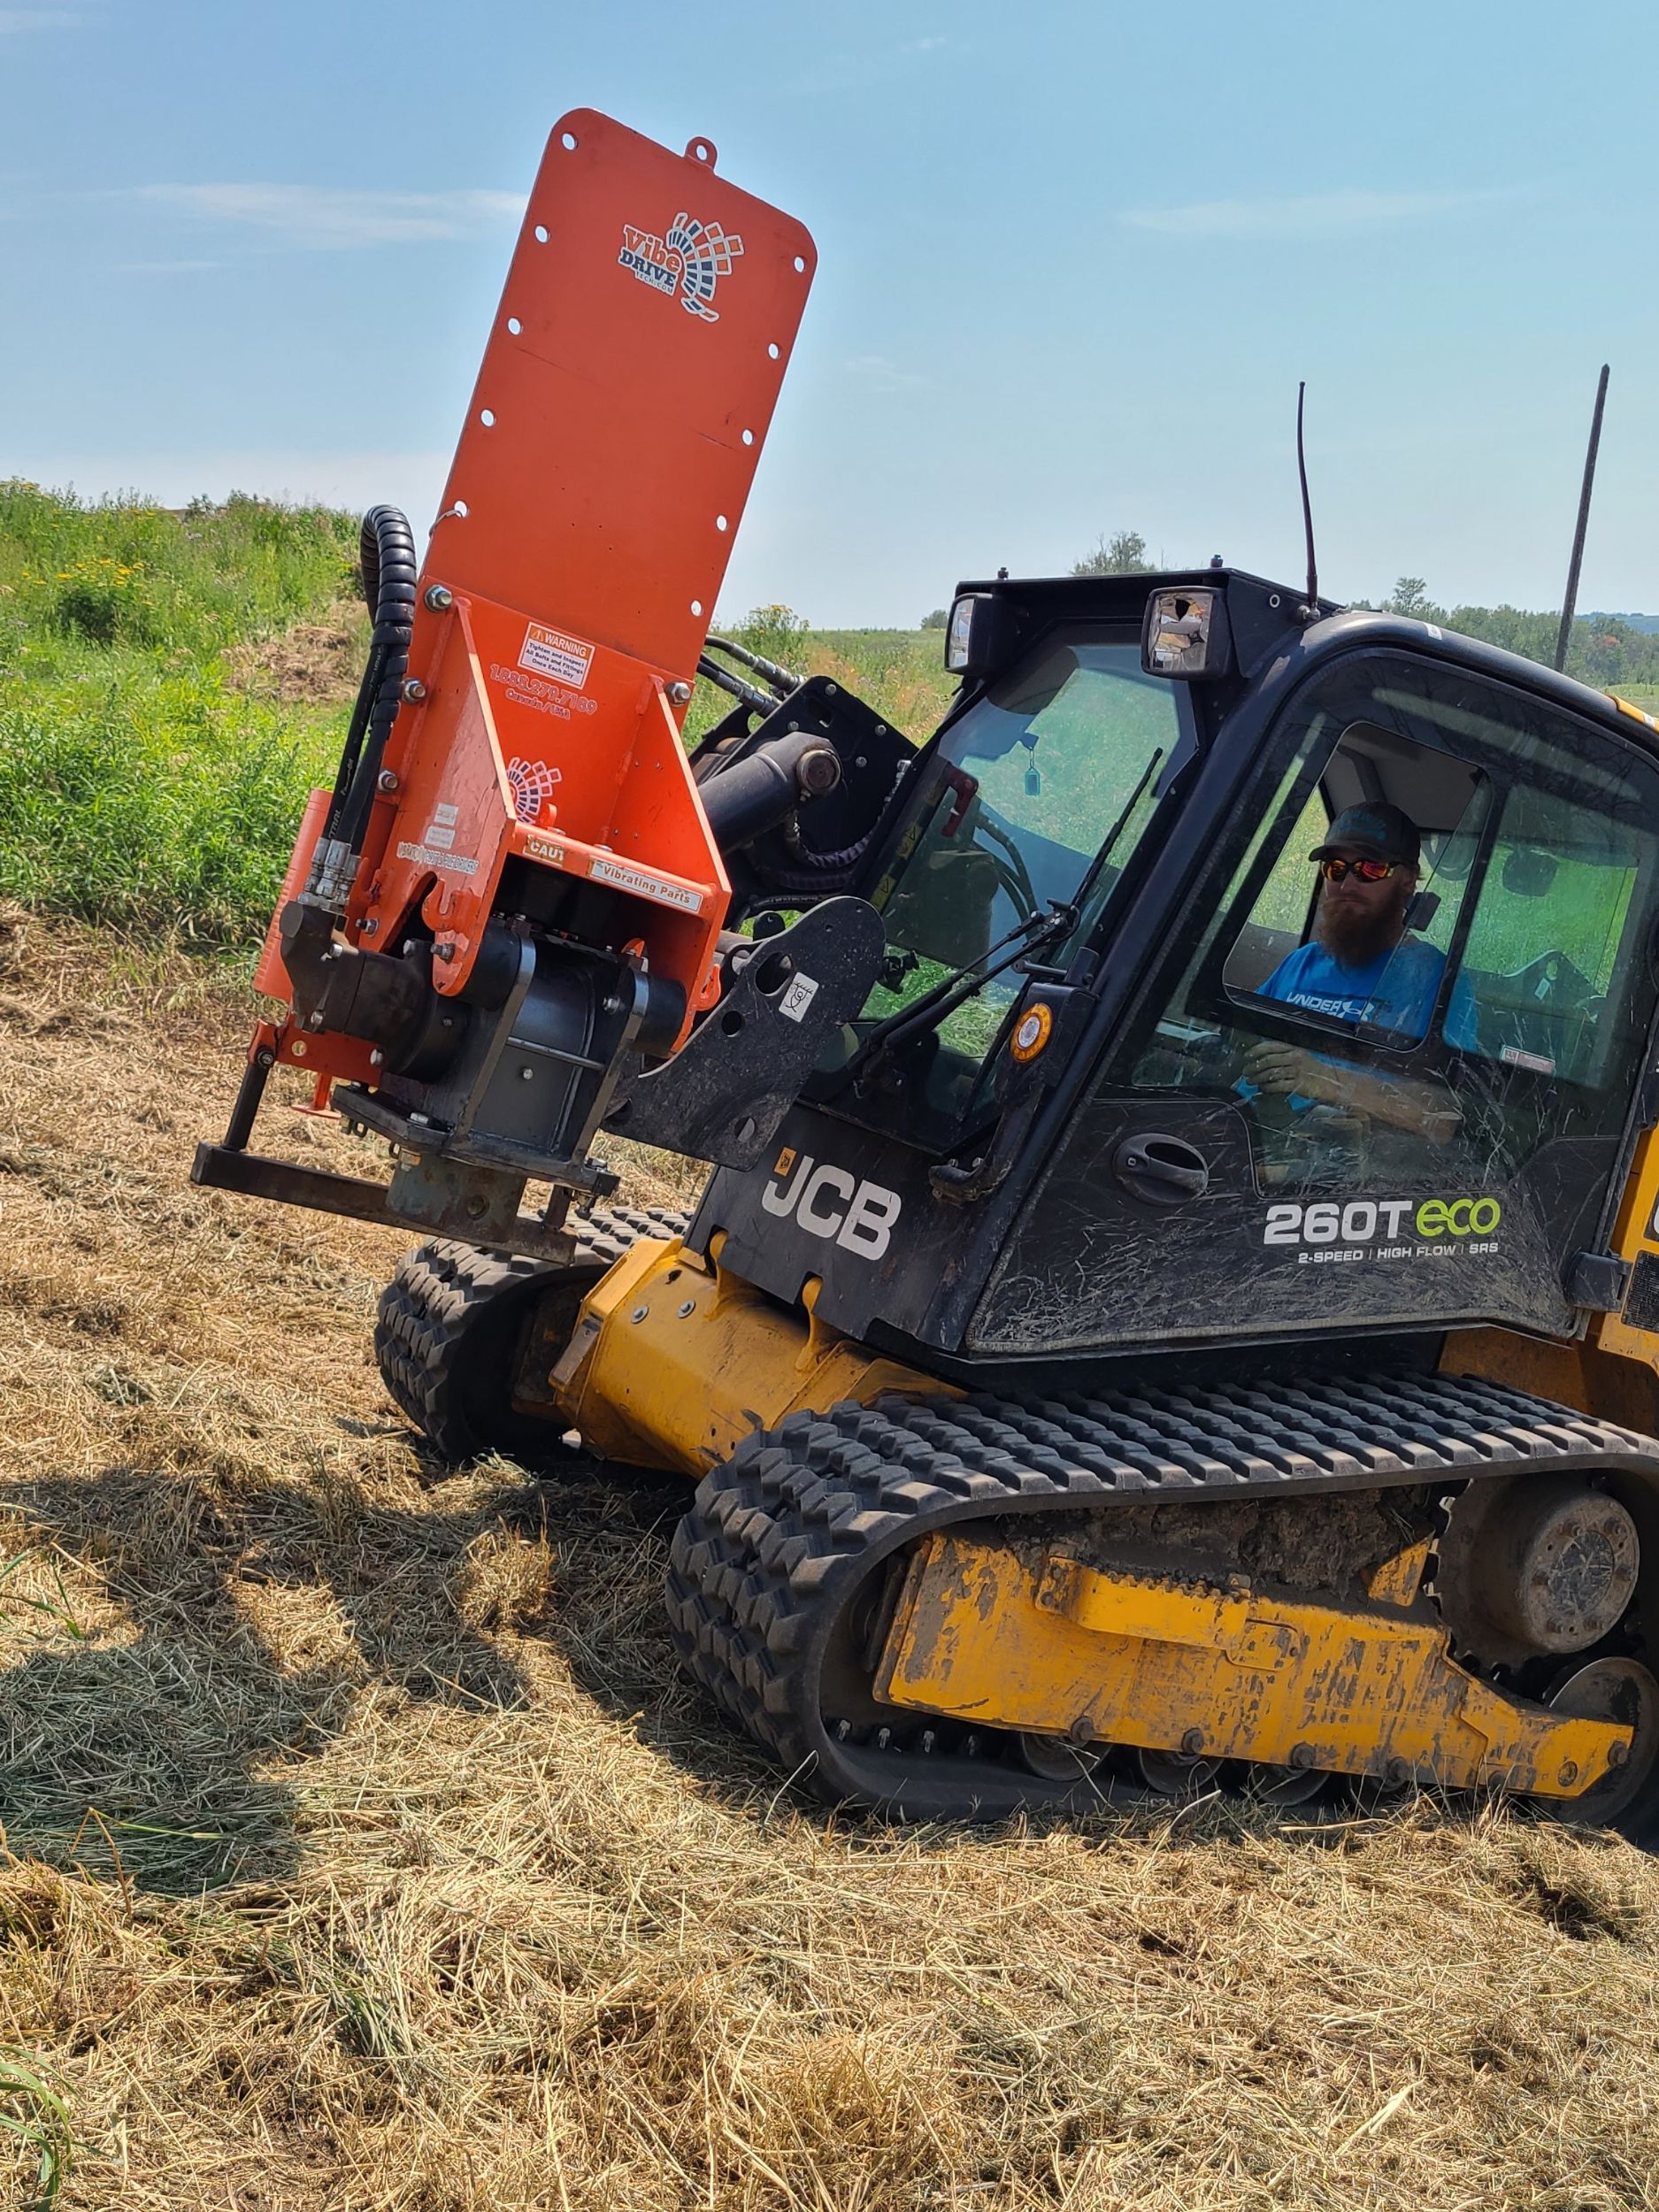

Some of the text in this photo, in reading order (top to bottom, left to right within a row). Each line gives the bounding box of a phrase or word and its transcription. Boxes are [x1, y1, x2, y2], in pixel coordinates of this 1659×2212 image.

[625, 226, 680, 273] Vibe
[619, 249, 677, 288] DRIVE
[636, 271, 673, 294] TECH.COM
[529, 642, 551, 655] Tighten
[563, 655, 585, 667] Inspect
[545, 633, 587, 657] WARNING
[532, 658, 574, 679] Once Each Day
[562, 662, 583, 674] Fittings
[328, 809, 342, 839] TRAL
[603, 864, 690, 904] Vibrating Parts
[1286, 992, 1342, 1011] UNDER
[762, 1155, 902, 1261] JCB
[1263, 1197, 1501, 1244] 260T eco
[1298, 1242, 1499, 1263] 2-SPEED HIGH FLOW SRS
